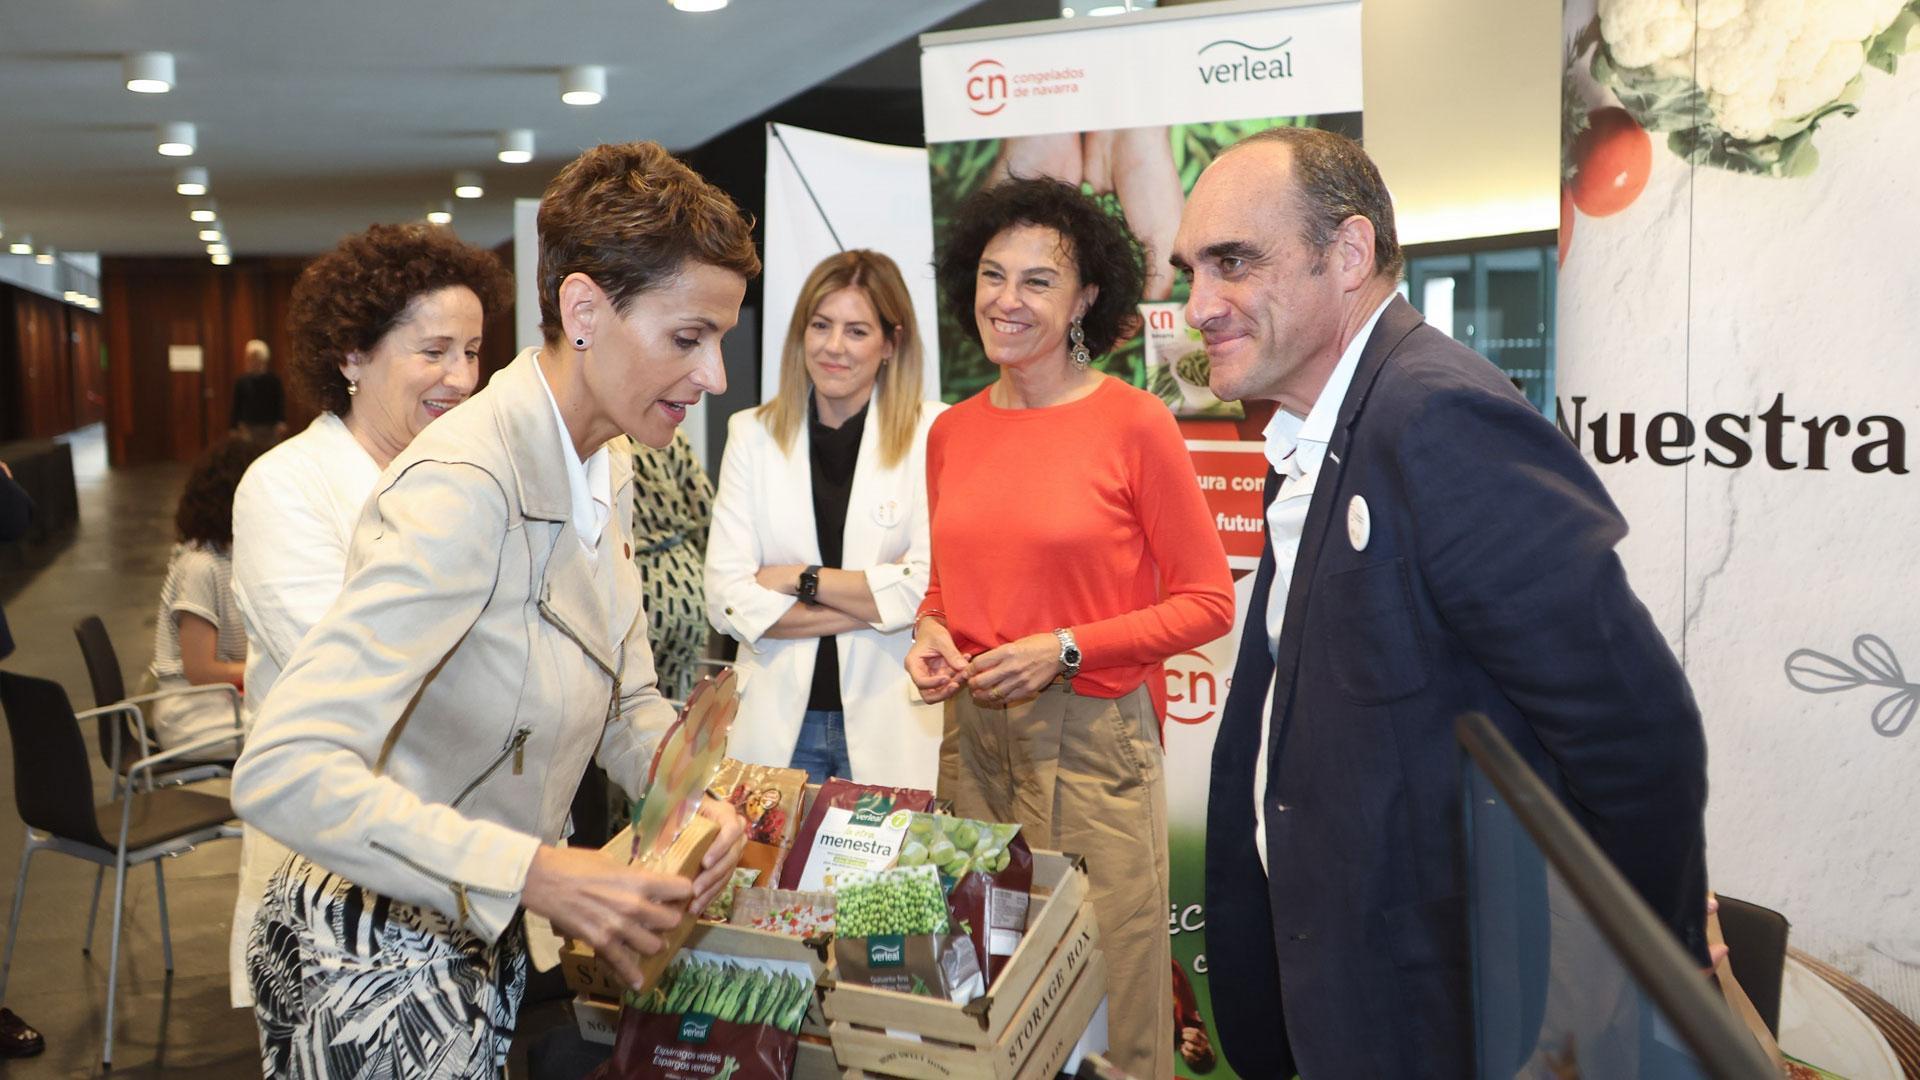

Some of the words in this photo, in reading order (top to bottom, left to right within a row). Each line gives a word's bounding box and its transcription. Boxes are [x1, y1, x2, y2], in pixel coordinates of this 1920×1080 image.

[1012, 67, 1085, 84] congelados
[1198, 51, 1293, 85] verleal
[966, 73, 1008, 101] cn
[1013, 88, 1030, 98] de
[1033, 83, 1079, 96] navarra
[1149, 310, 1174, 330] cn
[1556, 392, 1911, 475] Nuestra
[856, 812, 884, 823] verleal
[819, 833, 892, 857] menestra
[871, 950, 900, 962] verleal
[1009, 967, 1065, 1066] STORAGE
[683, 1027, 707, 1039] verleal
[652, 1055, 690, 1071] Espargos
[690, 1062, 716, 1075] verdes
[697, 1052, 722, 1064] verdes
